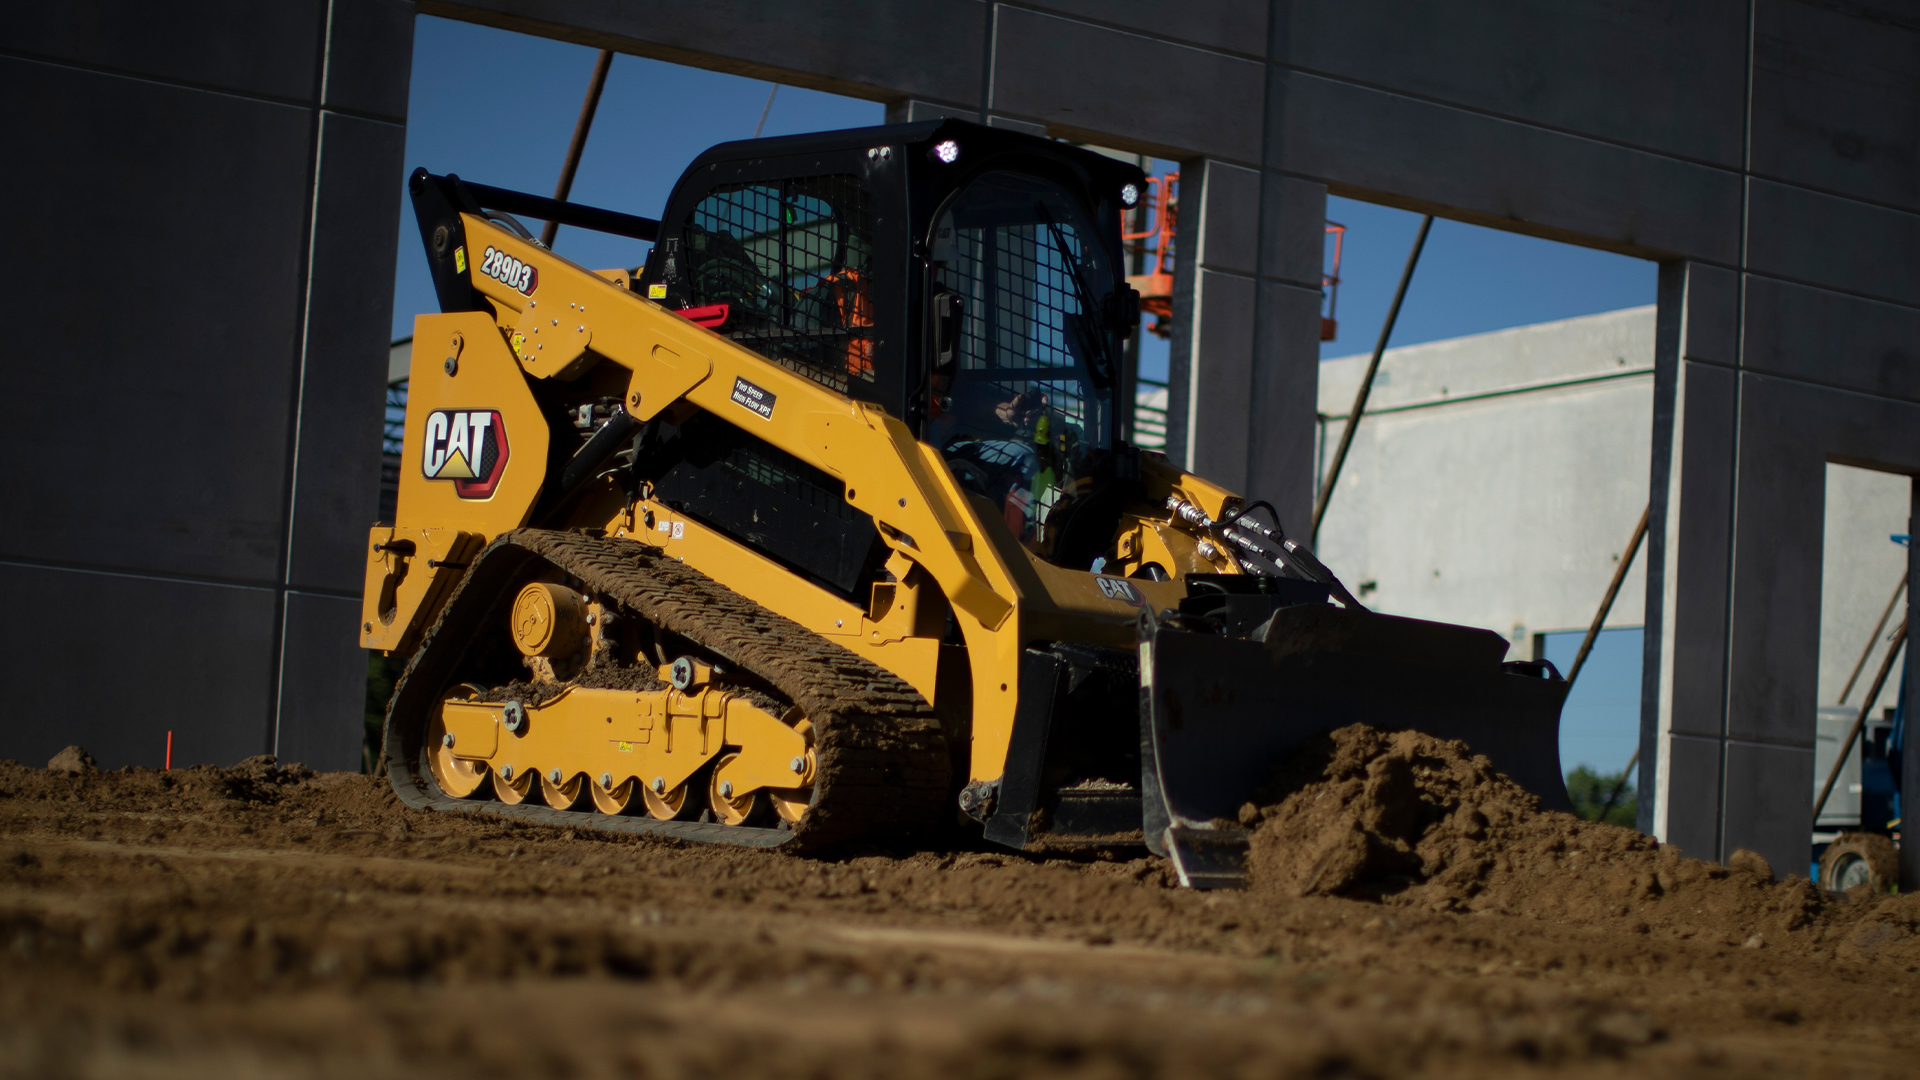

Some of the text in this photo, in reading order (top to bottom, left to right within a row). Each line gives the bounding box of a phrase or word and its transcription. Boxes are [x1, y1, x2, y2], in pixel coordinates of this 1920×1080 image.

[480, 246, 532, 292] 289D3
[746, 386, 764, 400] SPEED
[744, 397, 760, 410] FLOW
[758, 403, 771, 417] XPS
[423, 411, 492, 478] CAT
[1095, 577, 1136, 602] CAT
